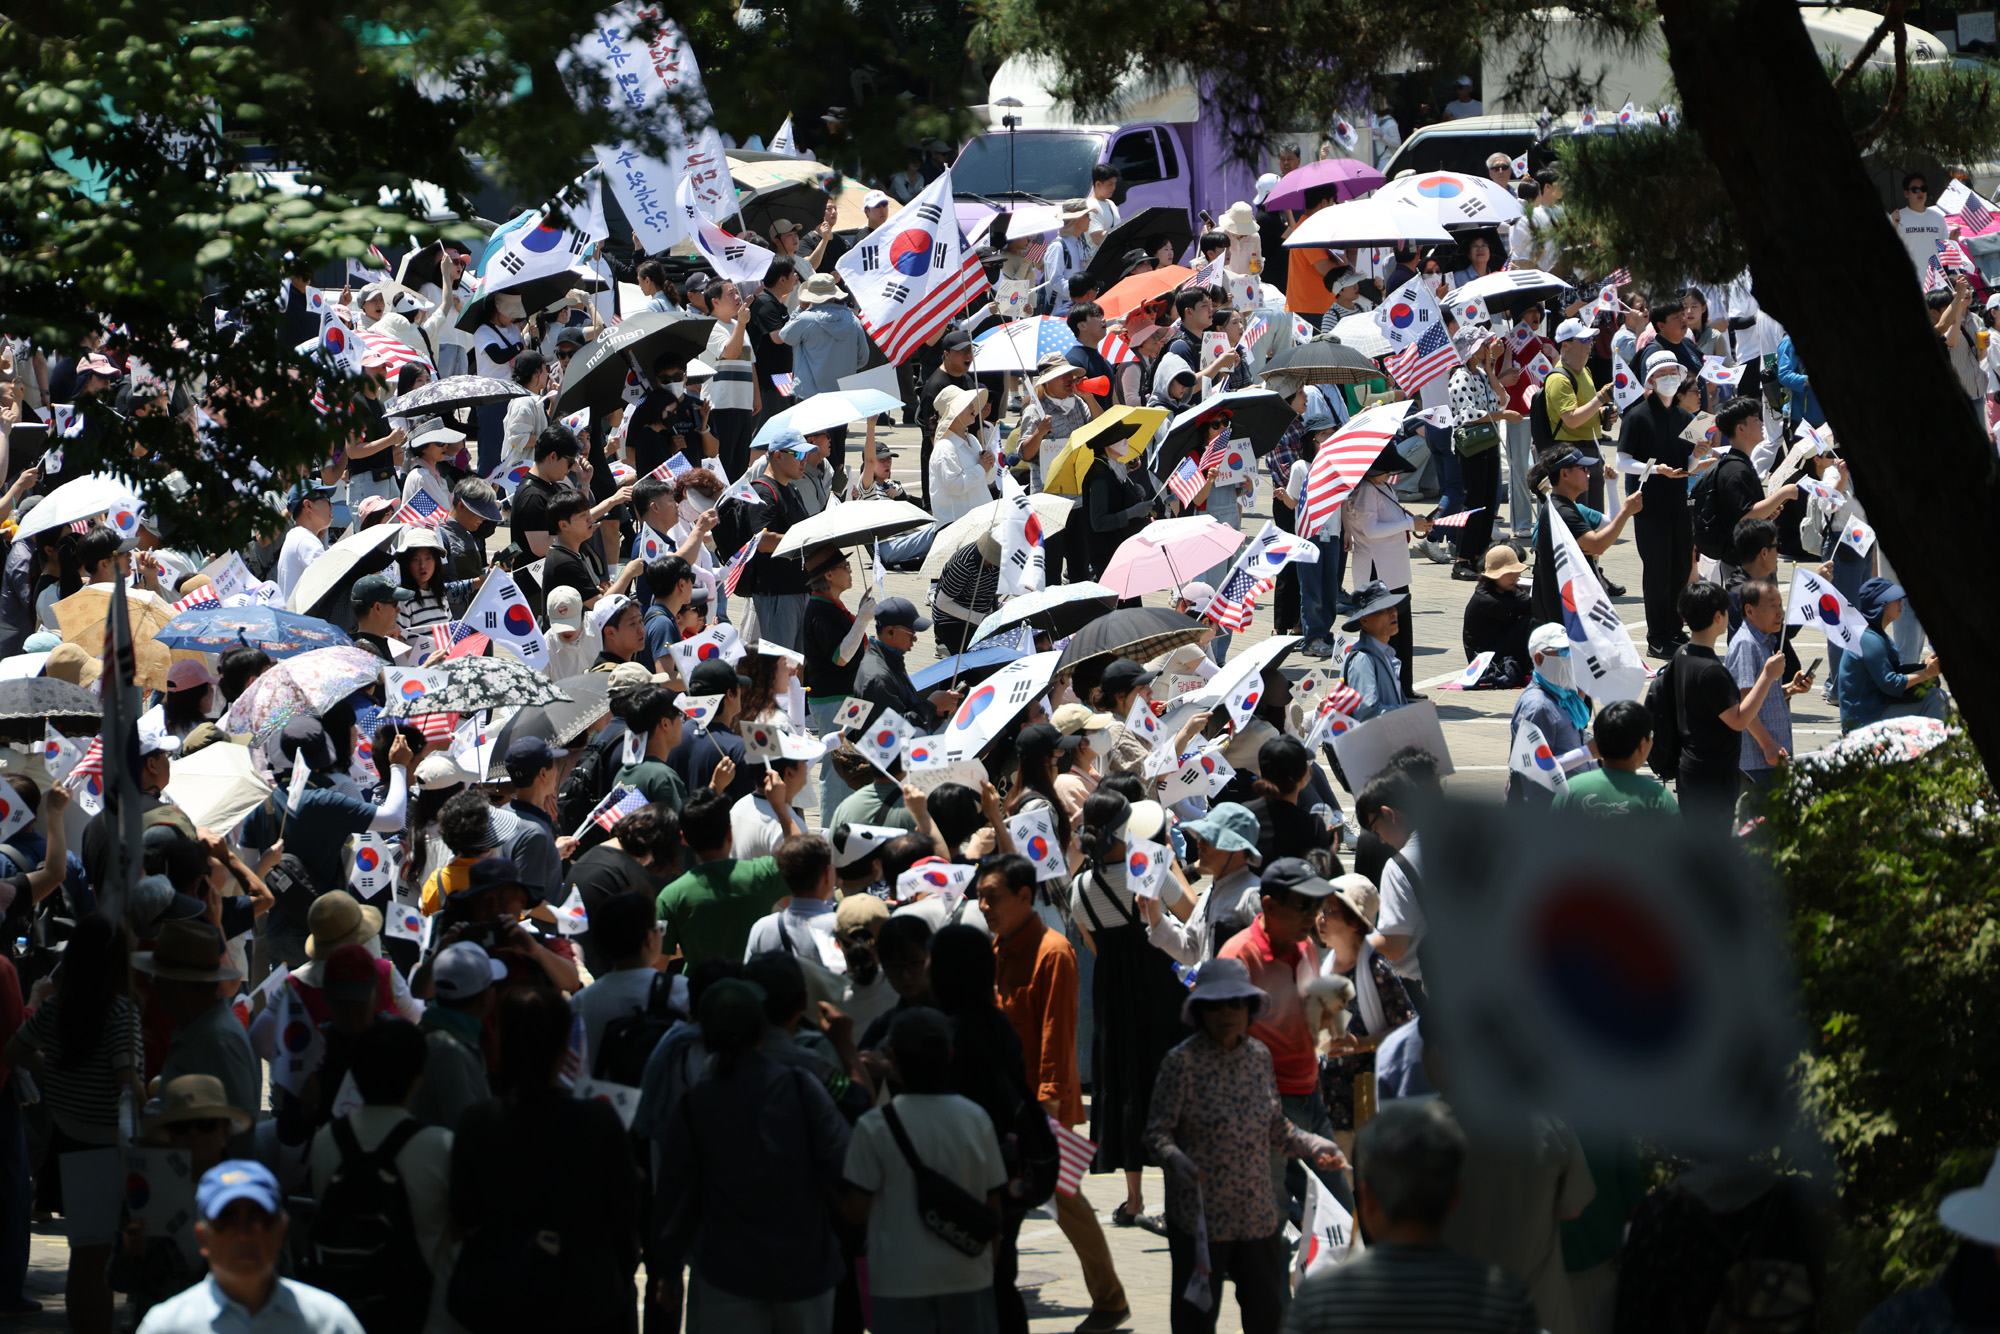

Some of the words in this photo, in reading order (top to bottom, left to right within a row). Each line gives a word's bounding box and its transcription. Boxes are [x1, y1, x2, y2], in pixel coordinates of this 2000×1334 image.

[586, 328, 645, 369] maruman
[1177, 681, 1202, 692] 당일투표
[926, 1209, 984, 1255] adidas
